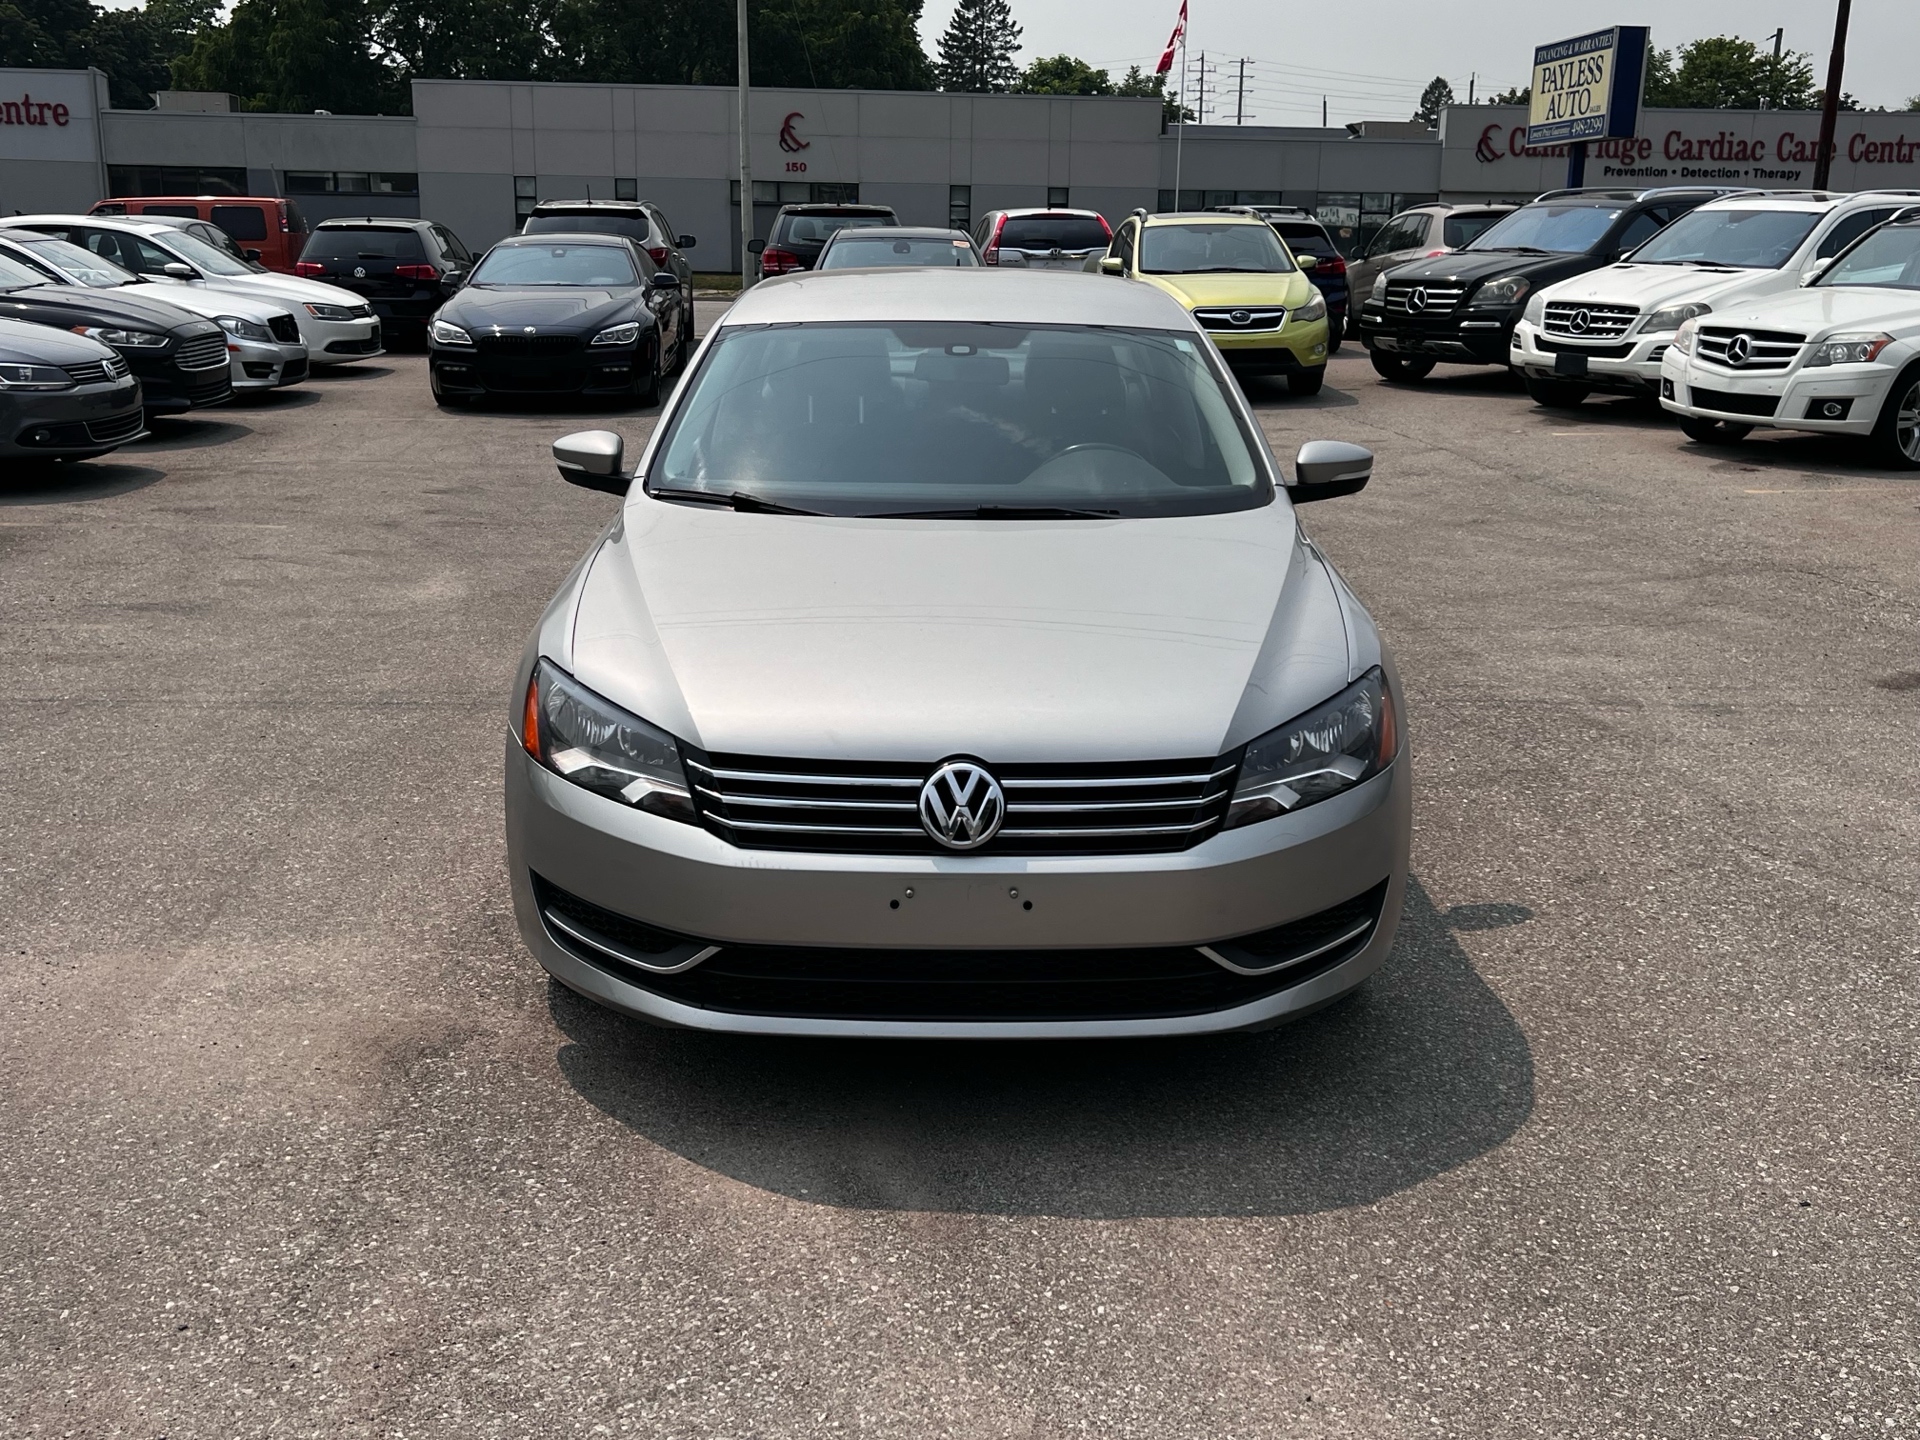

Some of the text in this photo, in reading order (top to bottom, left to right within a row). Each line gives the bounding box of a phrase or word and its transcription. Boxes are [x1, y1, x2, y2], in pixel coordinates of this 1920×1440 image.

[1537, 46, 1568, 63] FINANCING
[1574, 33, 1613, 52] WARRANTIES
[1540, 54, 1605, 95] PAYLESS
[1545, 88, 1591, 121] AUTO
[1663, 130, 1766, 162] Cardiac
[1776, 132, 1837, 163] Car
[785, 161, 807, 172] 150
[1604, 165, 1801, 181] Prevention Detection Therapy
